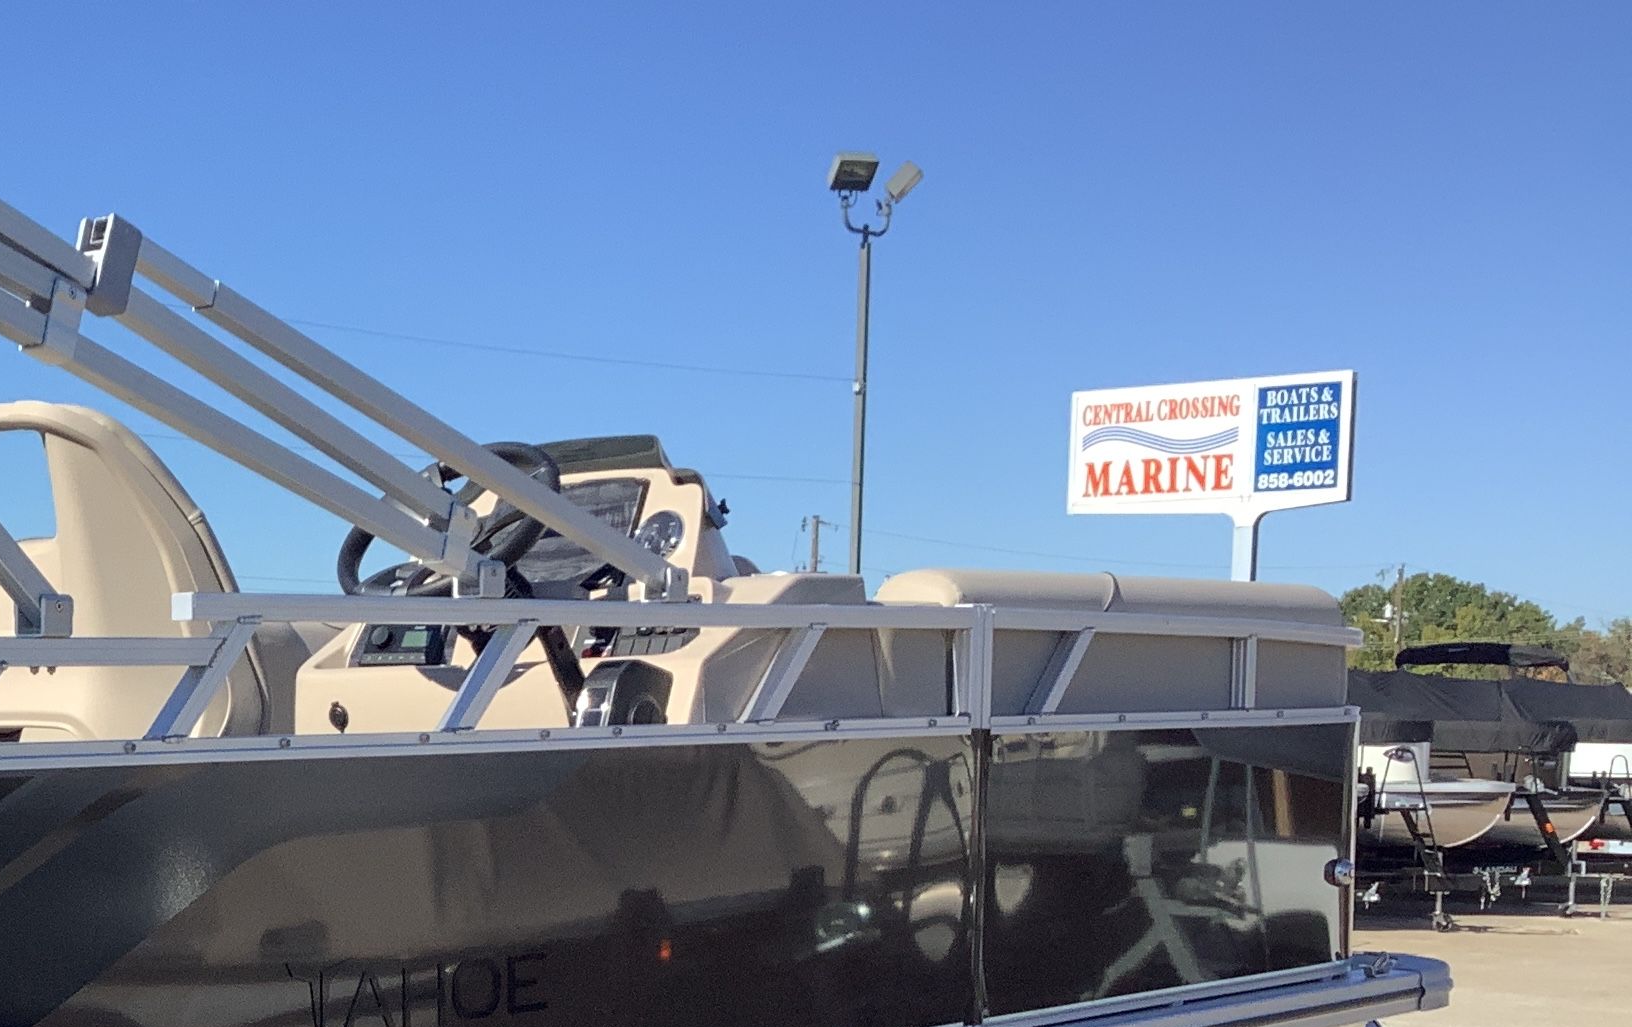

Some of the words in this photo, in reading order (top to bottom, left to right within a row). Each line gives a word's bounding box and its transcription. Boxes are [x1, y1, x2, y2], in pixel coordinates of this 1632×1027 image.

[1266, 386, 1319, 407] BOATS
[1321, 386, 1334, 402] &
[1082, 400, 1154, 427] CENTRAL
[1157, 394, 1241, 421] CROSSING
[1259, 402, 1338, 425] TRAILERS
[1266, 428, 1316, 448] SALES
[1317, 428, 1331, 444] &
[1263, 445, 1332, 466] SERVICE
[1082, 454, 1234, 498] MARINE
[1257, 468, 1335, 490] 858-6002
